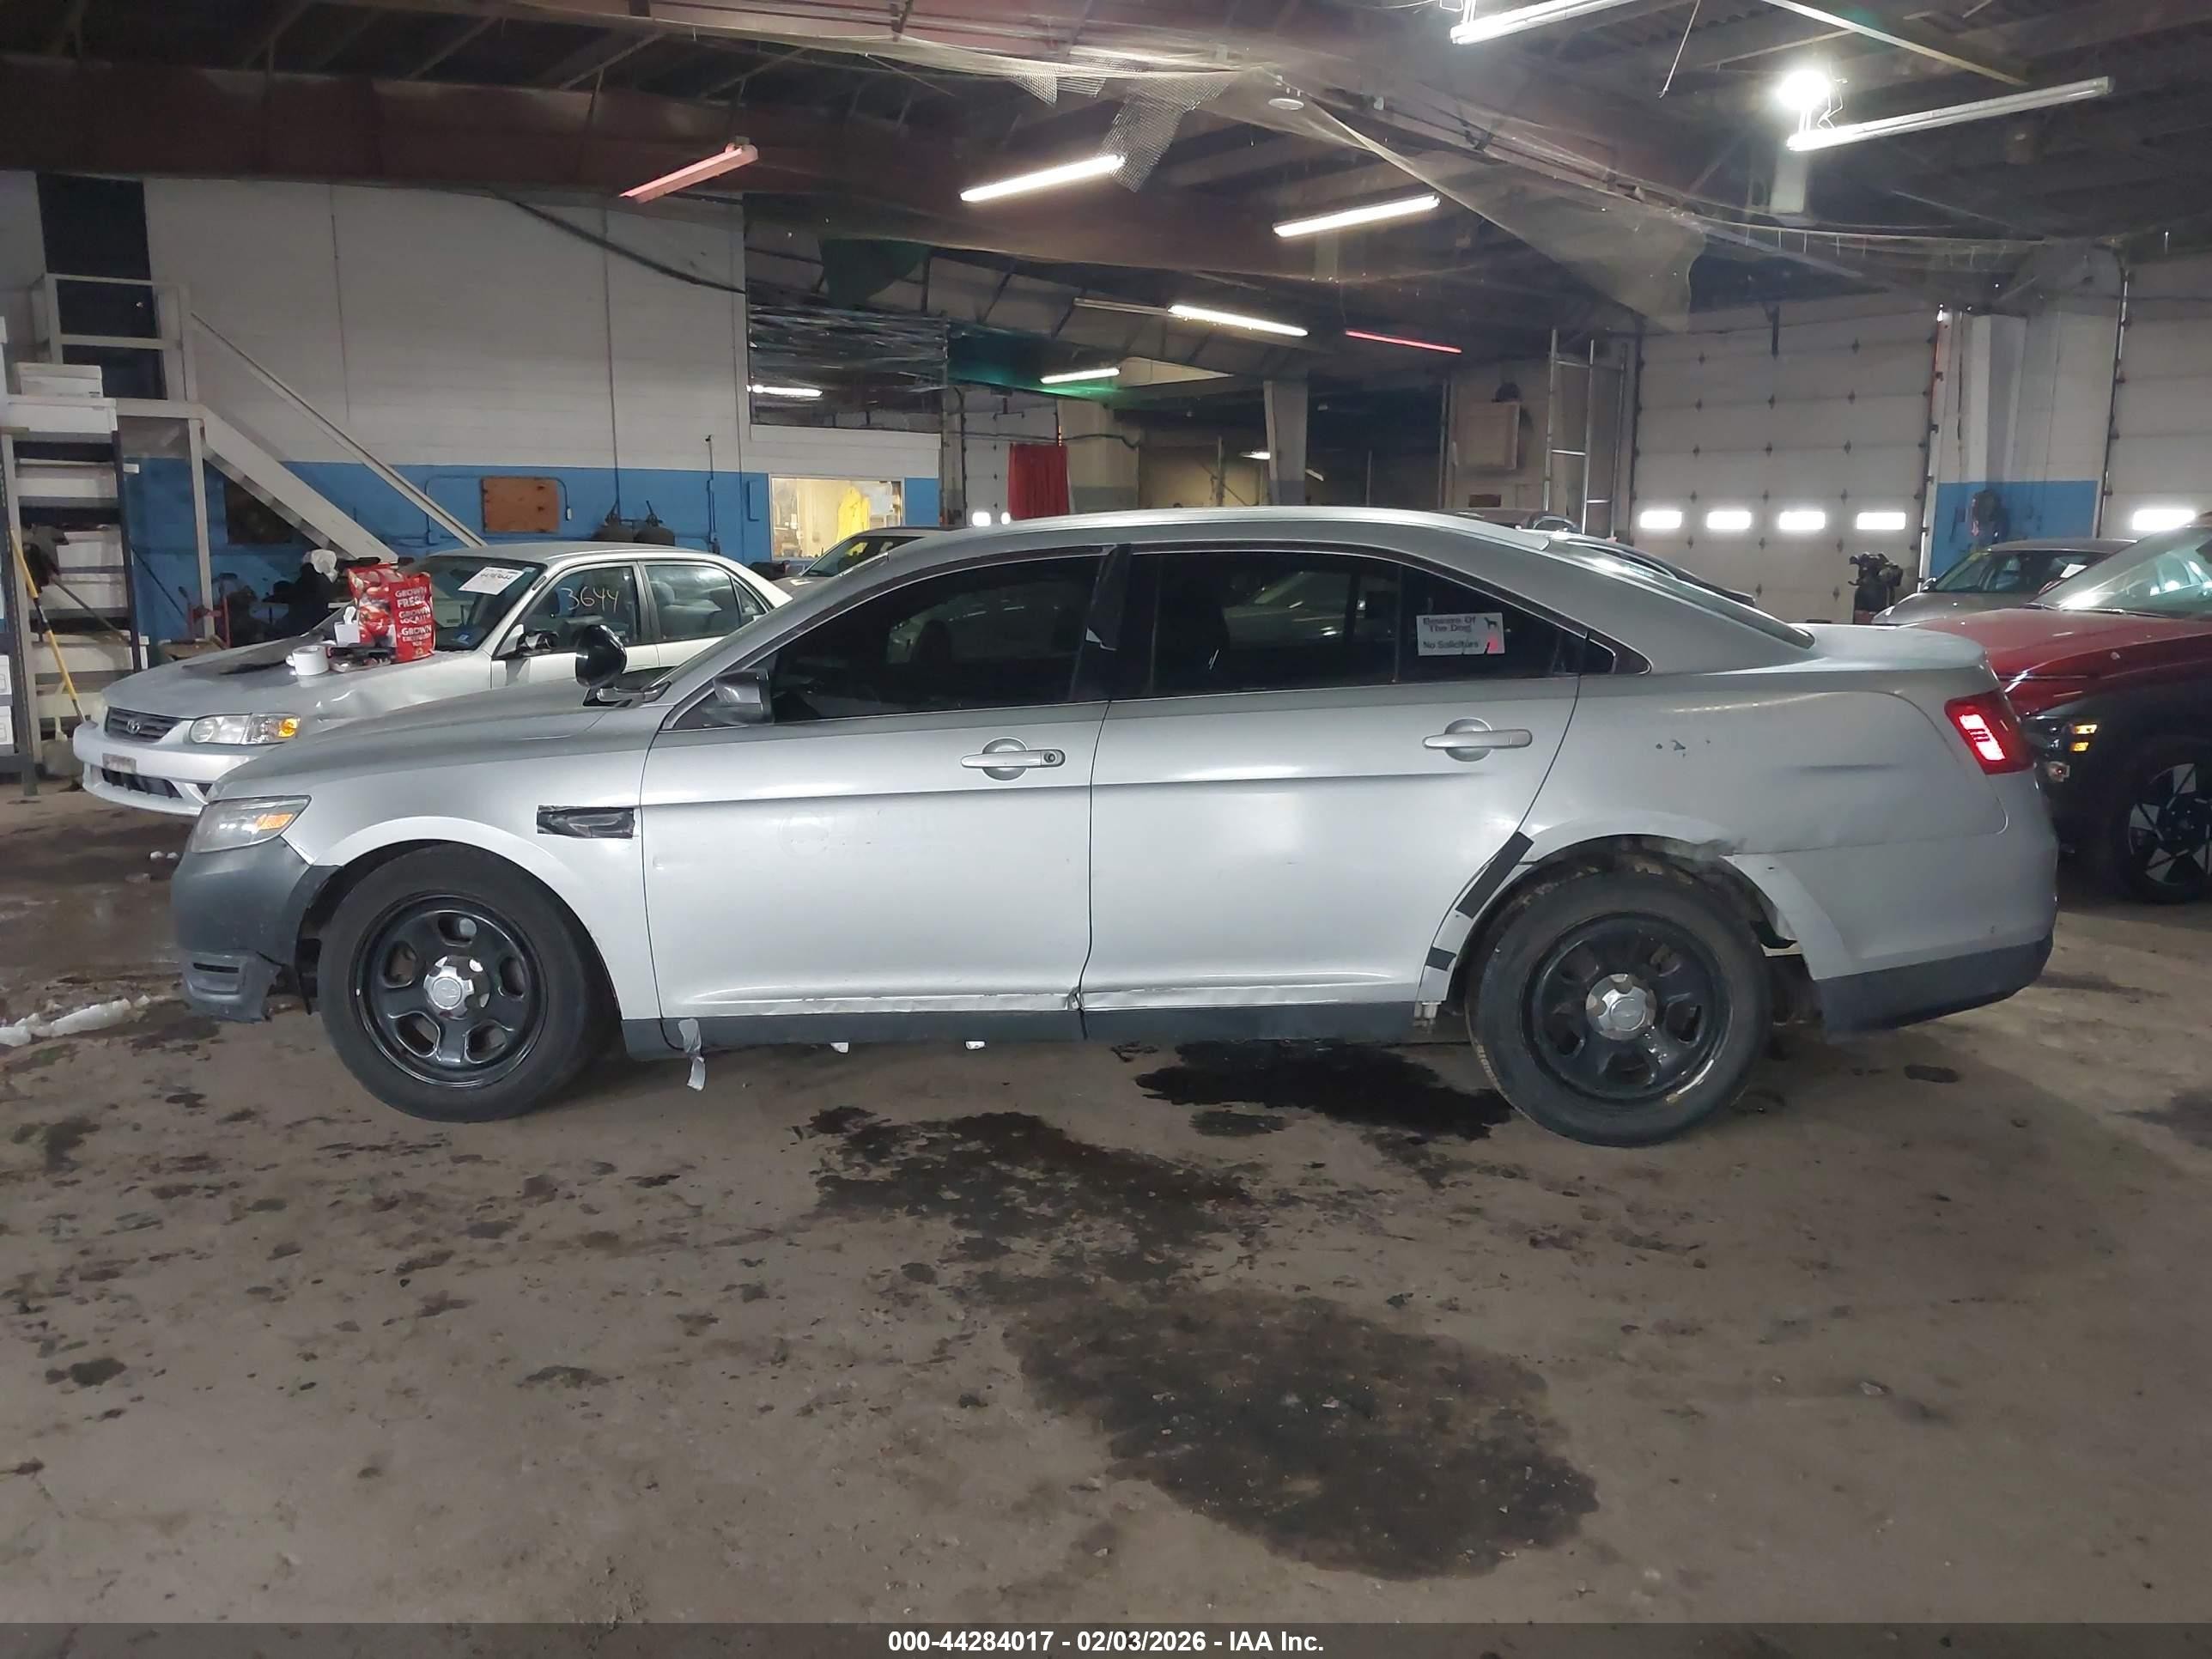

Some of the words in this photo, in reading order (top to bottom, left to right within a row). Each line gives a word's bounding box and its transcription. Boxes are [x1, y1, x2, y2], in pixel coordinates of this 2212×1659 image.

[395, 586, 427, 598] GROWN
[561, 586, 619, 613] 3644
[398, 606, 430, 618] GROWN
[1464, 616, 1476, 624] Of
[401, 624, 432, 635] GROWN
[1450, 624, 1471, 633] Dog
[1423, 641, 1436, 649] No
